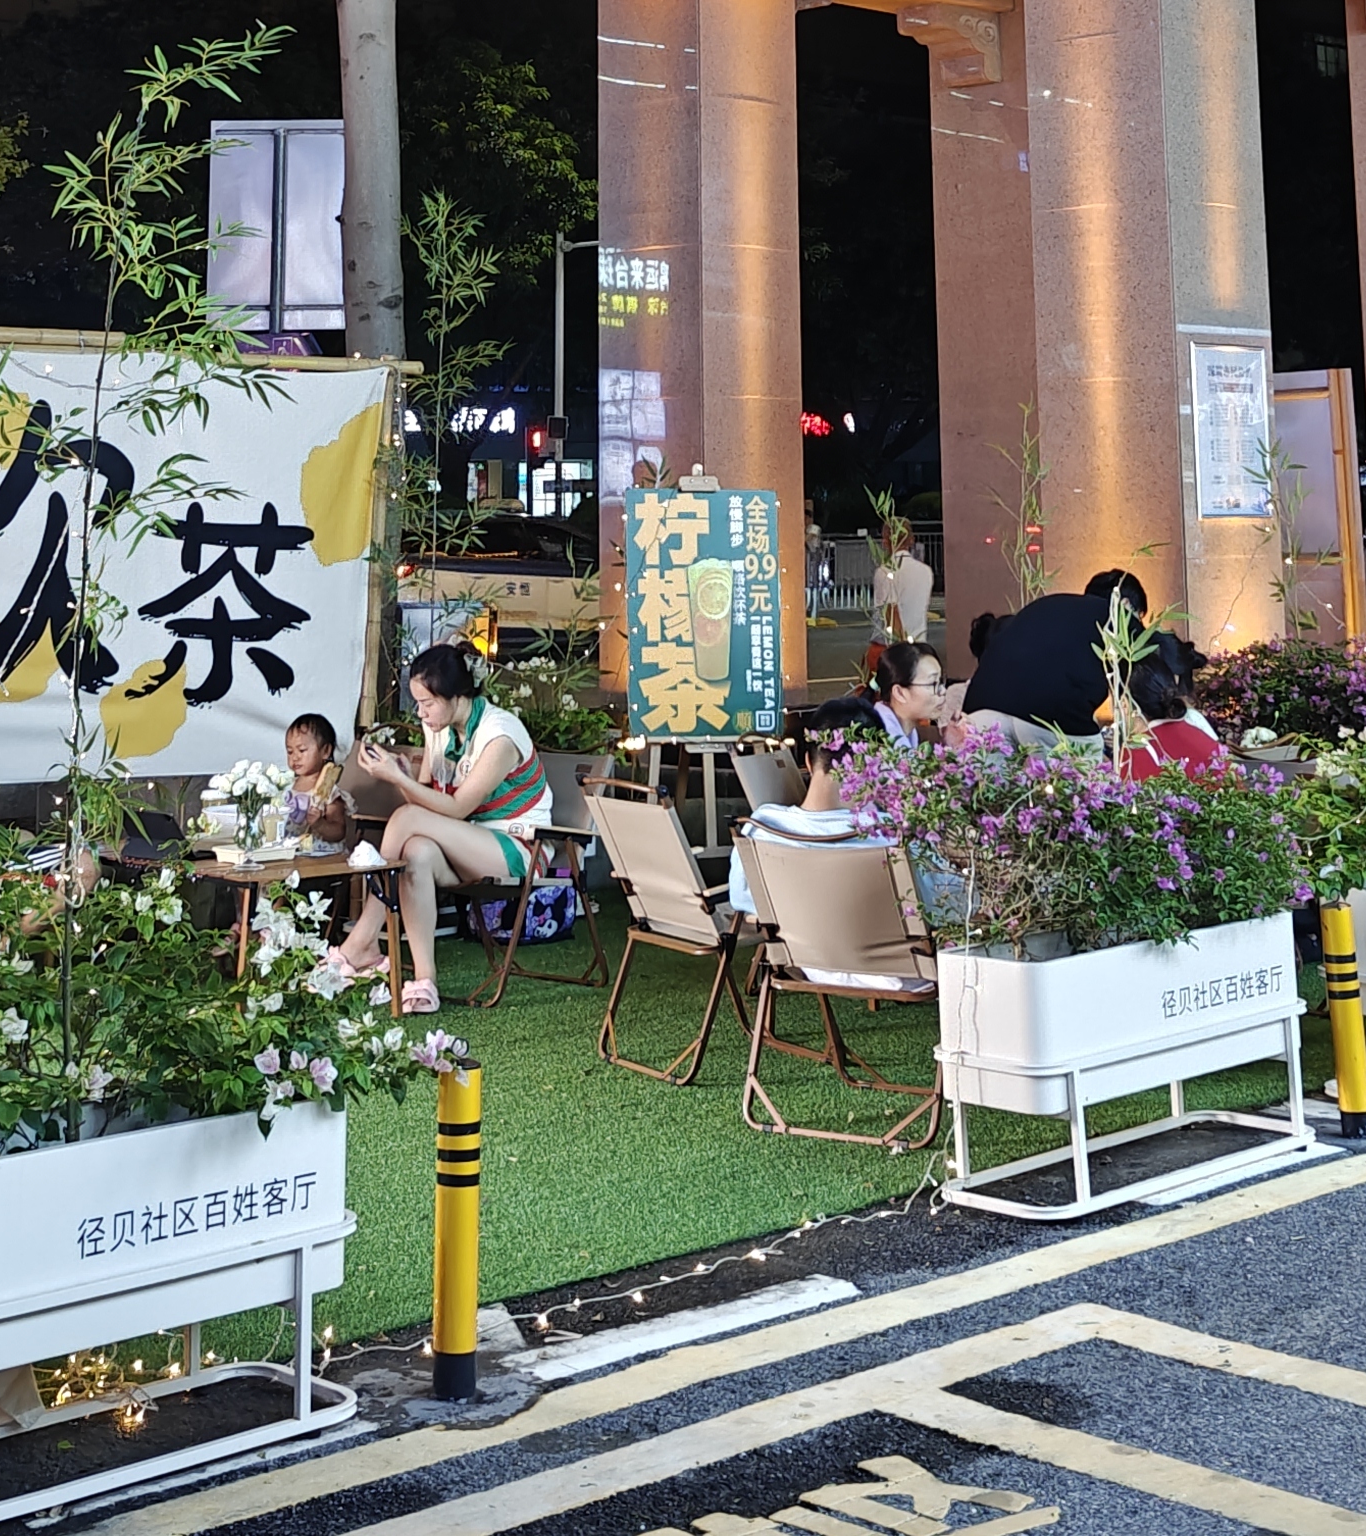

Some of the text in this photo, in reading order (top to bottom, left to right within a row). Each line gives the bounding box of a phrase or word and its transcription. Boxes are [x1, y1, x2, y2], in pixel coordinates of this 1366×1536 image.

[745, 495, 777, 613] 全场9.9元
[633, 492, 732, 733] 柠檬茶
[761, 615, 776, 710] LEMON TEA
[1161, 964, 1283, 1019] 径贝社区百姓客厅
[77, 1171, 318, 1260] 径贝社区百姓客厅
